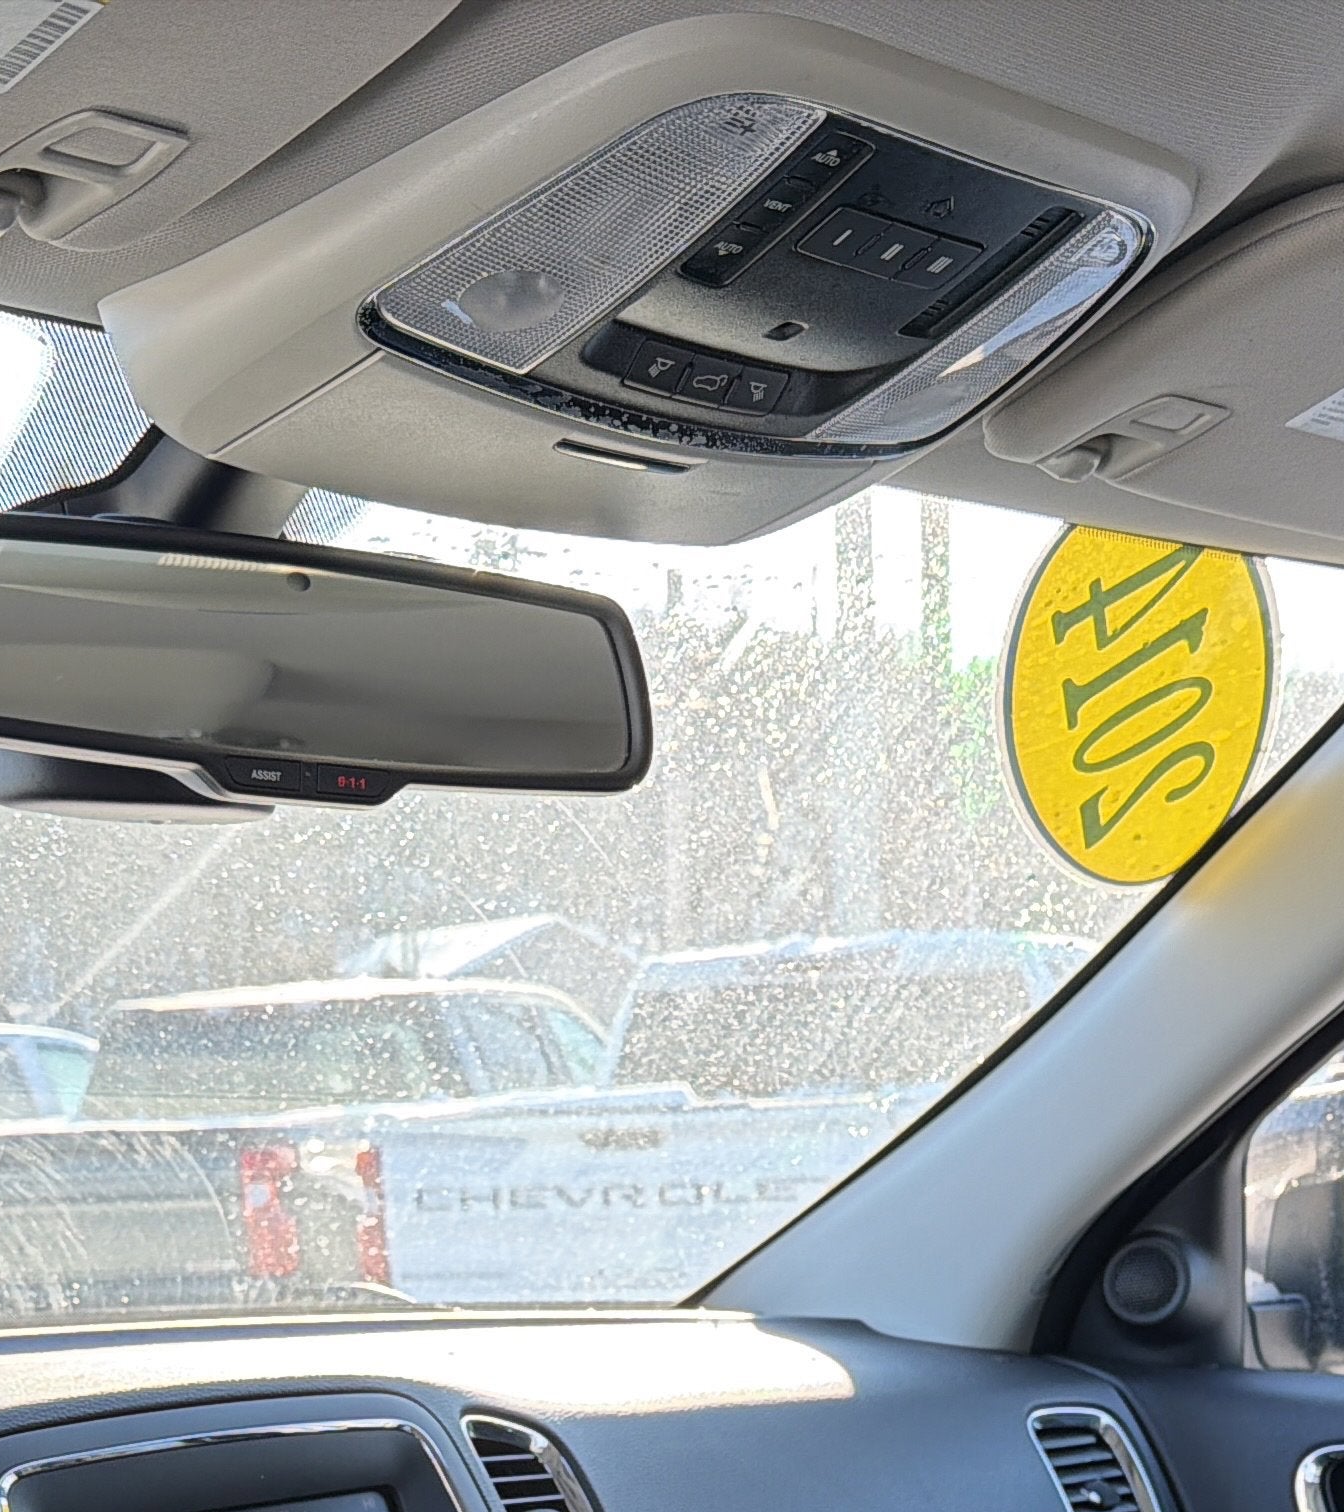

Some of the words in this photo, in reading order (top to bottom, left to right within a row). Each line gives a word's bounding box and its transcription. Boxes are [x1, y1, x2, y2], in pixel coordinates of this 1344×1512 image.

[811, 152, 841, 168] AUTO
[763, 198, 793, 213] VENT
[714, 240, 744, 255] AUTO
[251, 769, 282, 782] ASSIST
